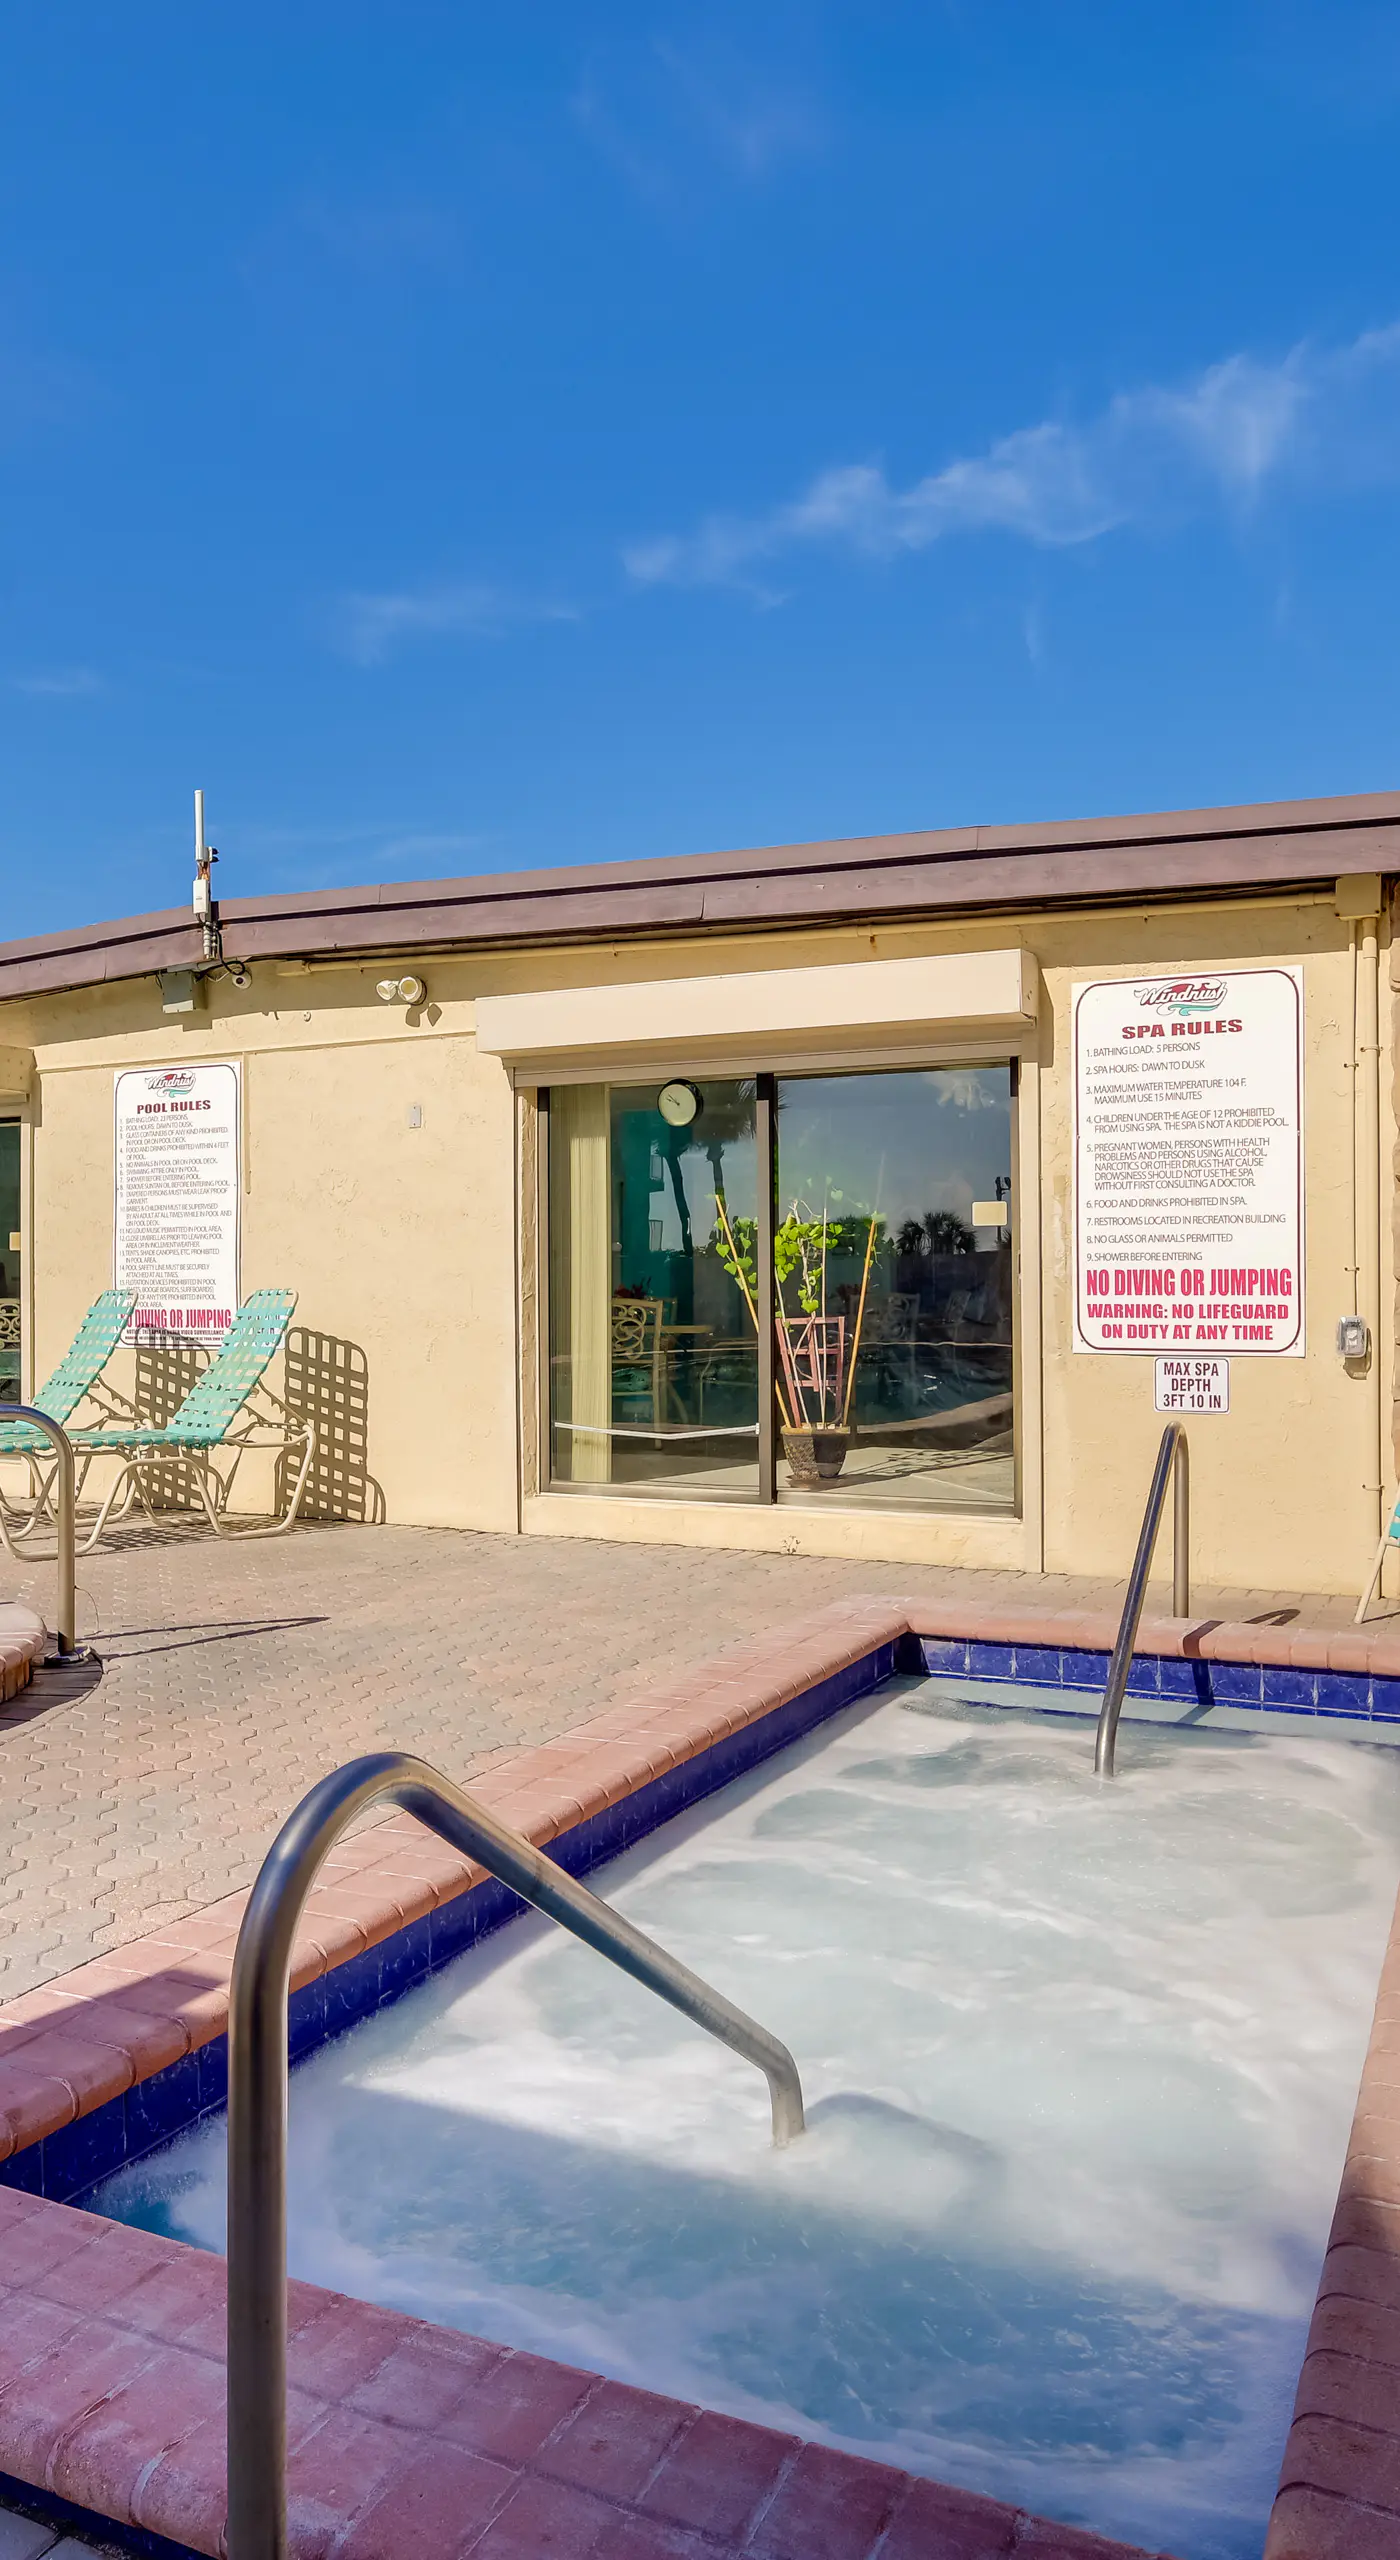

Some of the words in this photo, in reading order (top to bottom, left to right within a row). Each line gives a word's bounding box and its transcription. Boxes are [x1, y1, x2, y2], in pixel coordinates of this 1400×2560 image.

[1134, 979, 1228, 1006] Windrush
[1122, 1024, 1165, 1039] SPA
[1172, 1019, 1243, 1037] RULES
[1087, 1049, 1093, 1057] 1.
[1094, 1047, 1128, 1057] BATHING
[1129, 1045, 1154, 1055] LOAD:
[1156, 1045, 1162, 1053] 5
[1163, 1042, 1201, 1052] PERSONS
[1093, 1066, 1108, 1075] SPA
[1109, 1064, 1140, 1073] HOURS:
[1142, 1062, 1168, 1072] DAWN
[1169, 1061, 1181, 1070] TO
[1182, 1060, 1206, 1069] DUSK
[1086, 1087, 1092, 1095] 3.
[1093, 1084, 1136, 1094] MAXIMUM
[1136, 1082, 1164, 1092] WATER
[1164, 1079, 1223, 1091] TEMPERATURE
[1225, 1079, 1240, 1087] 104
[1241, 1078, 1247, 1087] F.
[1095, 1095, 1136, 1105] MAXIMUM
[1137, 1093, 1154, 1103] USE
[1155, 1093, 1165, 1102] 15
[1165, 1091, 1203, 1101] MINUTES
[137, 1103, 168, 1115] POOL
[171, 1100, 211, 1112] RULES
[1094, 1113, 1134, 1124] CHILDREN
[1134, 1112, 1163, 1122] UNDER
[1164, 1111, 1181, 1121] THE
[1181, 1110, 1199, 1120] AGE
[1200, 1110, 1212, 1119] OF
[1213, 1110, 1223, 1119] 12
[1224, 1108, 1275, 1118] PROHIBITED
[1095, 1123, 1119, 1134] FROM
[1119, 1122, 1145, 1133] USING
[1164, 1122, 1181, 1131] THE
[1181, 1121, 1197, 1130] SPA
[1198, 1120, 1206, 1129] IS
[1206, 1120, 1225, 1129] NOT
[1226, 1120, 1233, 1128] A
[1233, 1118, 1262, 1128] KIDDIE
[1087, 1144, 1093, 1153] 5.
[1094, 1142, 1137, 1152] PREGNANT
[1174, 1140, 1213, 1149] PERSONS
[1213, 1138, 1236, 1148] WITH
[1237, 1137, 1270, 1147] HEALTH
[1095, 1152, 1137, 1162] PROBLEMS
[1138, 1151, 1157, 1160] AND
[1158, 1150, 1196, 1160] PERSONS
[1197, 1149, 1224, 1159] USING
[1095, 1161, 1140, 1171] NARCOTICS
[1140, 1161, 1153, 1170] OR
[1153, 1160, 1182, 1170] OTHER
[1182, 1159, 1212, 1169] DRUGS
[1213, 1158, 1235, 1168] THAT
[1235, 1157, 1265, 1167] CAUSE
[1095, 1171, 1147, 1181] DROWSINESS
[1148, 1170, 1183, 1180] SHOULD
[1183, 1169, 1203, 1179] NOT
[1203, 1169, 1220, 1178] USE
[1221, 1168, 1238, 1178] THE
[1238, 1168, 1255, 1177] SPA
[1095, 1181, 1133, 1191] WITHOUT
[1134, 1181, 1155, 1190] FIRST
[1155, 1179, 1209, 1189] CONSULTING
[1209, 1179, 1217, 1188] A
[1087, 1200, 1093, 1209] 6.
[1094, 1200, 1118, 1209] FOOD
[1119, 1199, 1138, 1208] AND
[1139, 1198, 1169, 1208] DRINKS
[1170, 1197, 1219, 1207] PROHIBITED
[1220, 1197, 1229, 1206] IN
[1087, 1218, 1093, 1226] 7.
[1094, 1217, 1144, 1226] RESTROOMS
[1144, 1216, 1182, 1225] LOCATED
[1183, 1216, 1192, 1225] IN
[1192, 1215, 1244, 1225] RECREATION
[1245, 1214, 1287, 1224] BUILDING
[1087, 1236, 1093, 1244] 8.
[1094, 1235, 1108, 1244] NO
[1108, 1235, 1134, 1244] GLASS
[1135, 1235, 1147, 1244] OR
[1147, 1234, 1186, 1243] ANIMALS
[1186, 1233, 1234, 1243] PERMITTED
[1087, 1254, 1093, 1262] 9.
[1094, 1253, 1130, 1262] SHOWER
[1130, 1252, 1161, 1261] BEFORE
[1162, 1252, 1203, 1261] ENTERING
[1087, 1269, 1110, 1296] NO
[1115, 1269, 1176, 1296] DIVING
[1181, 1269, 1205, 1296] OR
[1210, 1268, 1292, 1296] JUMPING
[135, 1309, 167, 1328] DIVING
[170, 1309, 183, 1328] OR
[186, 1309, 232, 1328] JUMPING
[1087, 1304, 1168, 1319] WARNING:
[1172, 1304, 1195, 1320] NO
[1199, 1304, 1289, 1320] LIFEGUARD
[1102, 1324, 1123, 1339] ON
[1127, 1324, 1169, 1340] DUTY
[1173, 1325, 1192, 1340] AT
[1196, 1325, 1228, 1340] ANY
[1232, 1325, 1274, 1341] TIME
[1164, 1363, 1191, 1376] MAX
[1195, 1363, 1220, 1377] SPA
[1172, 1379, 1212, 1393] DEPTH
[1163, 1395, 1186, 1408] 3FT
[1190, 1395, 1205, 1408] 10
[1209, 1395, 1222, 1409] IN
